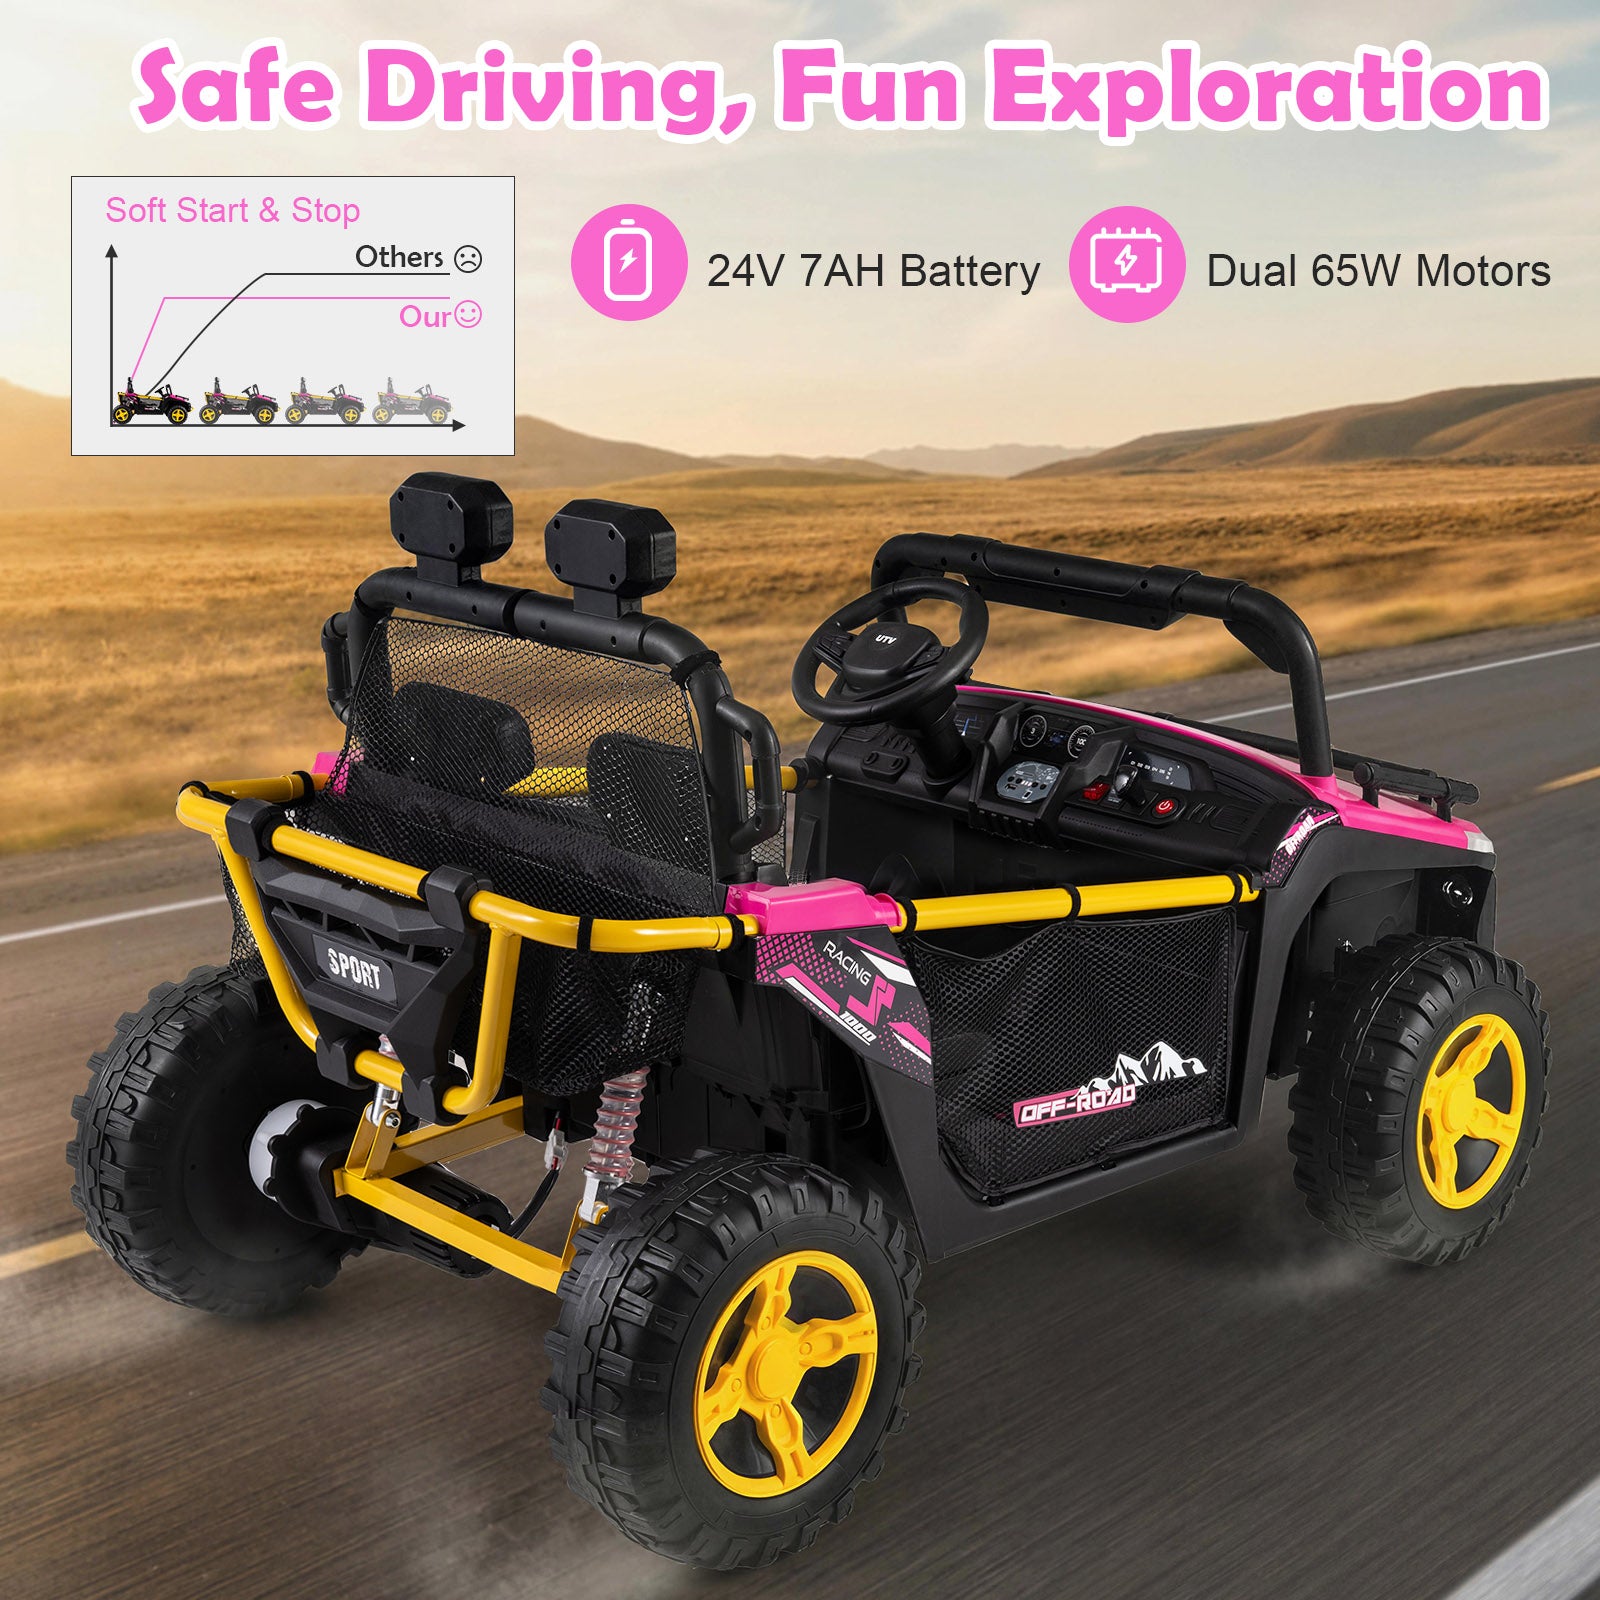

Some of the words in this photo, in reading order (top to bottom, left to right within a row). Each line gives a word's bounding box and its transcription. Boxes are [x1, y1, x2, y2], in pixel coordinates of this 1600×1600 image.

[875, 633, 897, 645] UTV
[327, 947, 380, 990] SPORT
[822, 940, 872, 987] RACING
[839, 1010, 877, 1043] 1000
[1020, 1083, 1137, 1123] OFF-ROAD
